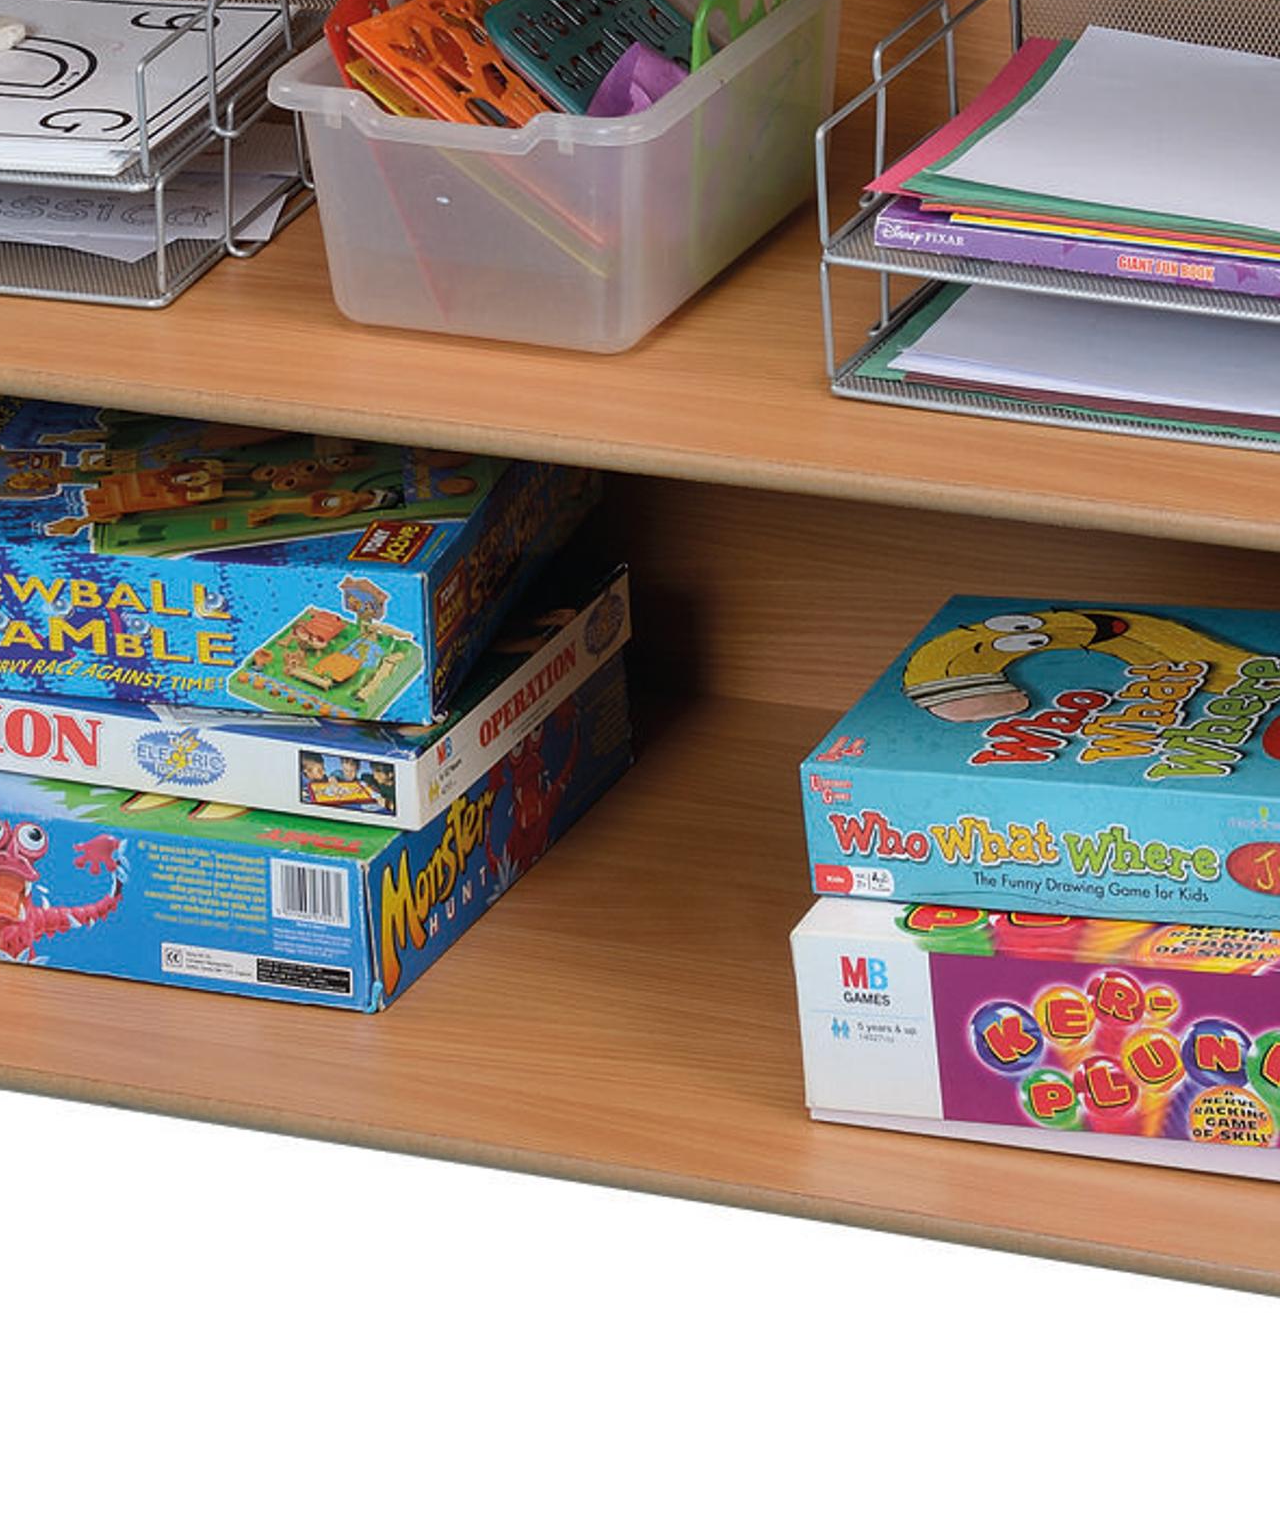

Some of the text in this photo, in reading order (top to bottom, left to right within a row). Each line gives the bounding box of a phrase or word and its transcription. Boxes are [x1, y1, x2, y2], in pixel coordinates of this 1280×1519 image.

[881, 223, 965, 247] Disney PIXAR
[1116, 254, 1154, 274] GIANT
[30, 658, 81, 676] RACE
[84, 662, 166, 688] AGAINST
[170, 674, 224, 691] TIME!
[479, 641, 578, 749] OPERATION
[969, 689, 1110, 765] Who
[1078, 659, 1209, 764] What
[435, 736, 453, 766] MB
[828, 810, 1219, 880] Who What Where
[380, 789, 496, 997] Monster
[428, 864, 488, 938] HUNT
[974, 872, 1209, 903] The Funny Drawing Game for Kids
[1155, 945, 1186, 955] OF
[840, 955, 888, 990] MB
[843, 990, 891, 1007] GAMES
[1193, 1106, 1268, 1122] RACKING
[1205, 1116, 1258, 1131] GAME
[1192, 1127, 1214, 1138] OF
